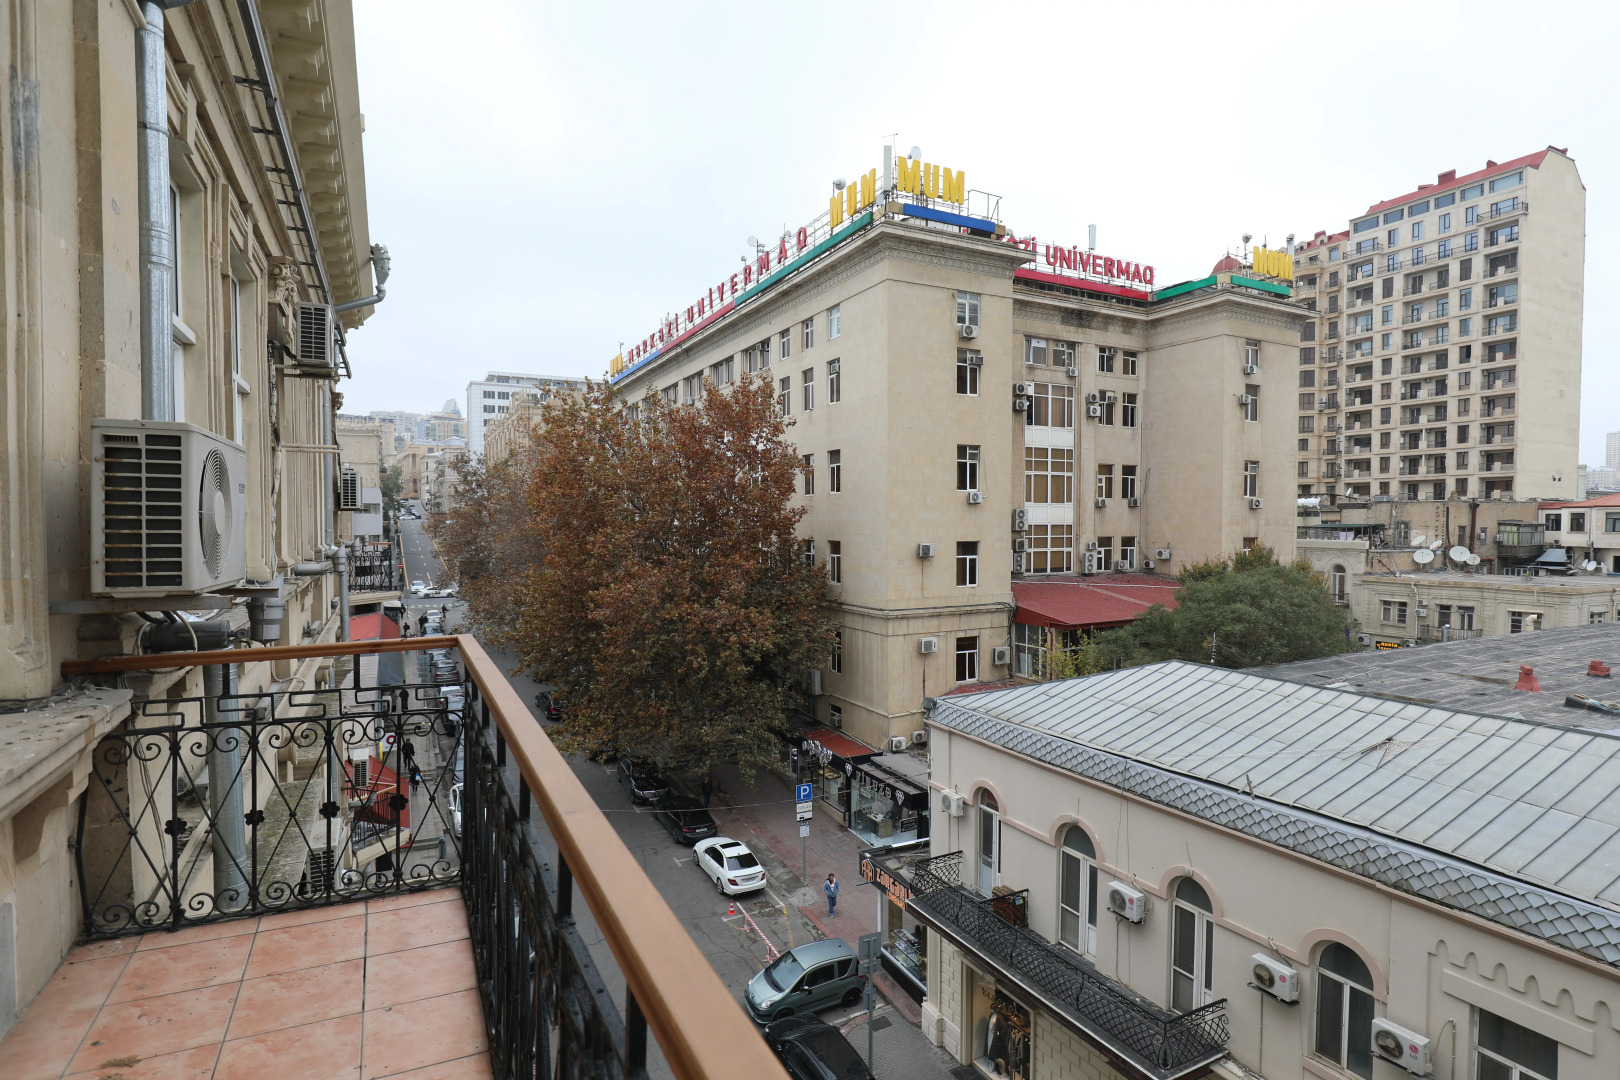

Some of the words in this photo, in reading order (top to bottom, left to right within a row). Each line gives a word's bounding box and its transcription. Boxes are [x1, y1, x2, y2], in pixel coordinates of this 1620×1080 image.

[830, 168, 876, 229] MUM
[897, 156, 965, 205] MUM
[1046, 245, 1154, 285] UNİVERMAQ
[1253, 246, 1293, 281] MUM
[800, 786, 810, 799] P
